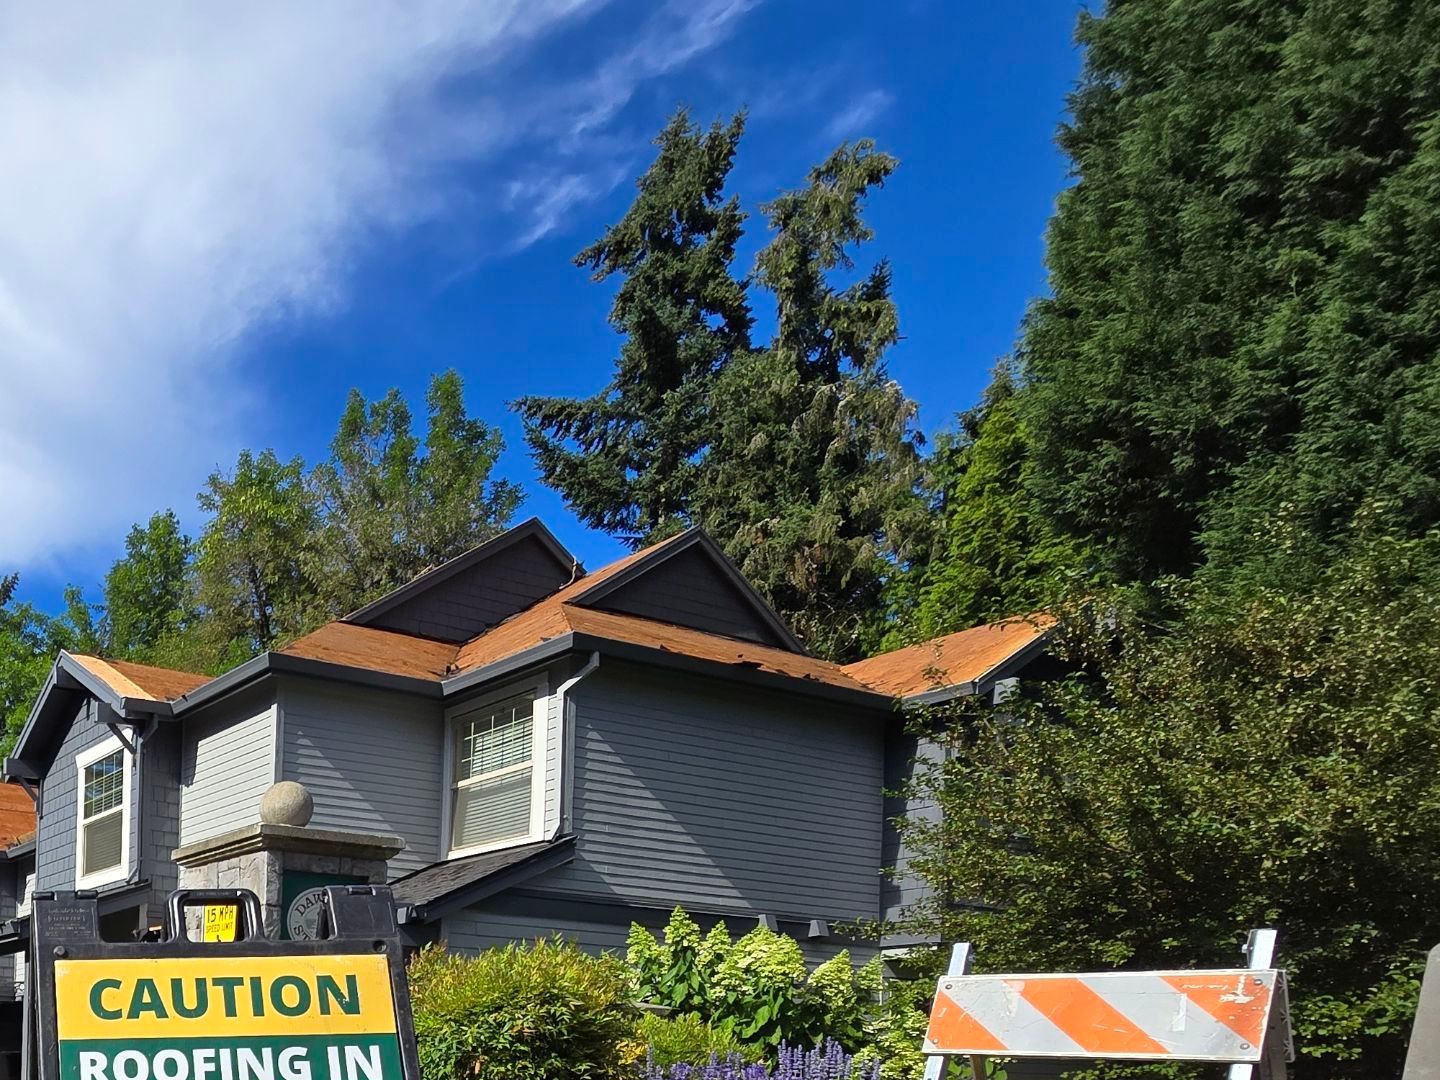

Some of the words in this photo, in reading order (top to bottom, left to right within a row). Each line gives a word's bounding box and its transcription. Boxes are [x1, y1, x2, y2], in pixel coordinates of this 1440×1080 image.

[207, 908, 216, 923] 15
[219, 904, 233, 921] MPH
[206, 923, 220, 933] SPEED
[221, 921, 233, 931] LIMIT
[89, 974, 361, 1021] CAUTION
